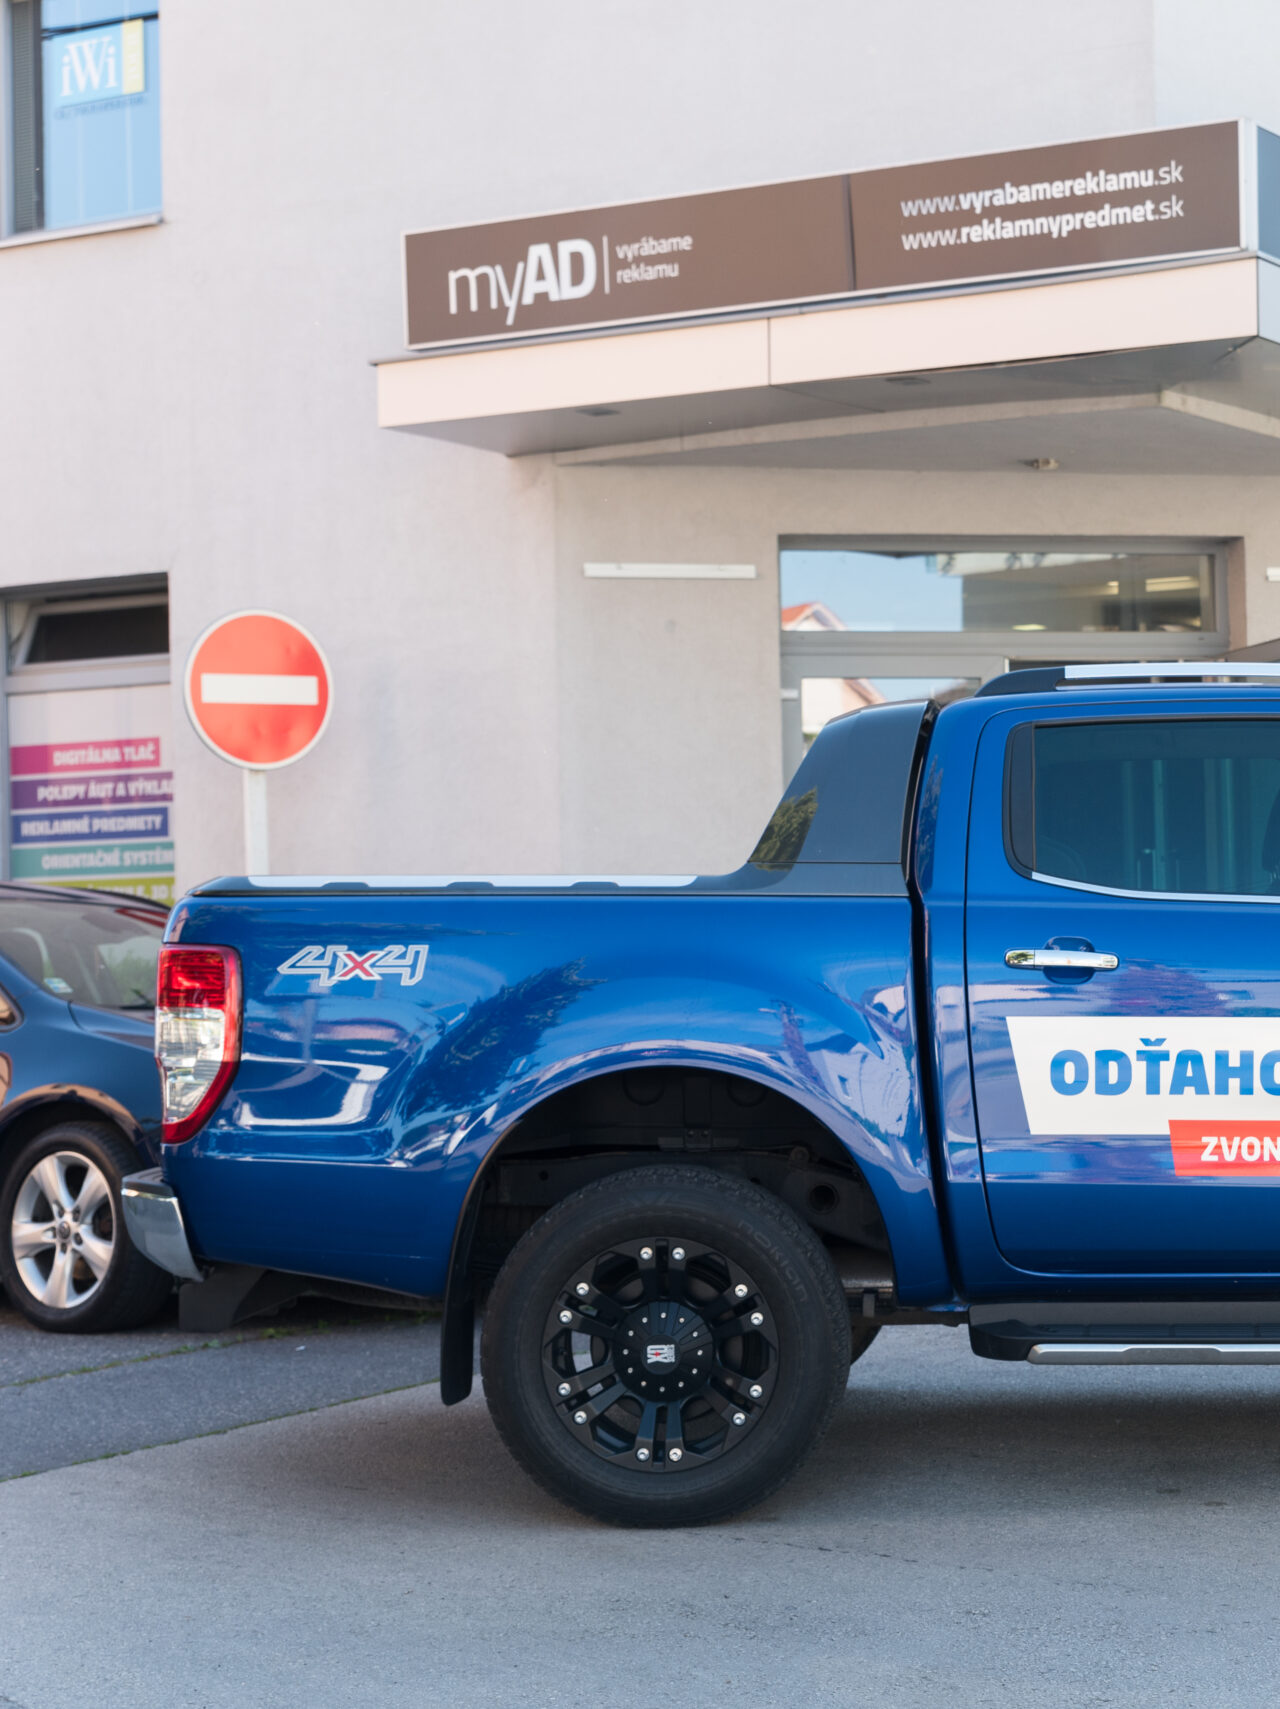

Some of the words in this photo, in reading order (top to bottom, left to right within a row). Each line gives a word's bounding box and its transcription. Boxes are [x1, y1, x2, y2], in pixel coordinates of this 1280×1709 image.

[900, 160, 1184, 218] www.vyrabamereklamu.sk
[901, 195, 1185, 251] www.reklamnypredmet.sk
[615, 234, 693, 262] vyrábame
[448, 238, 597, 326] myAD
[616, 260, 679, 284] reklamu
[53, 746, 122, 767] DIGITÁLNA
[124, 742, 156, 762] TLAČ
[37, 783, 87, 802] POLEPY
[20, 814, 90, 837] REKLAMNÉ
[92, 814, 163, 834] PREDMETY
